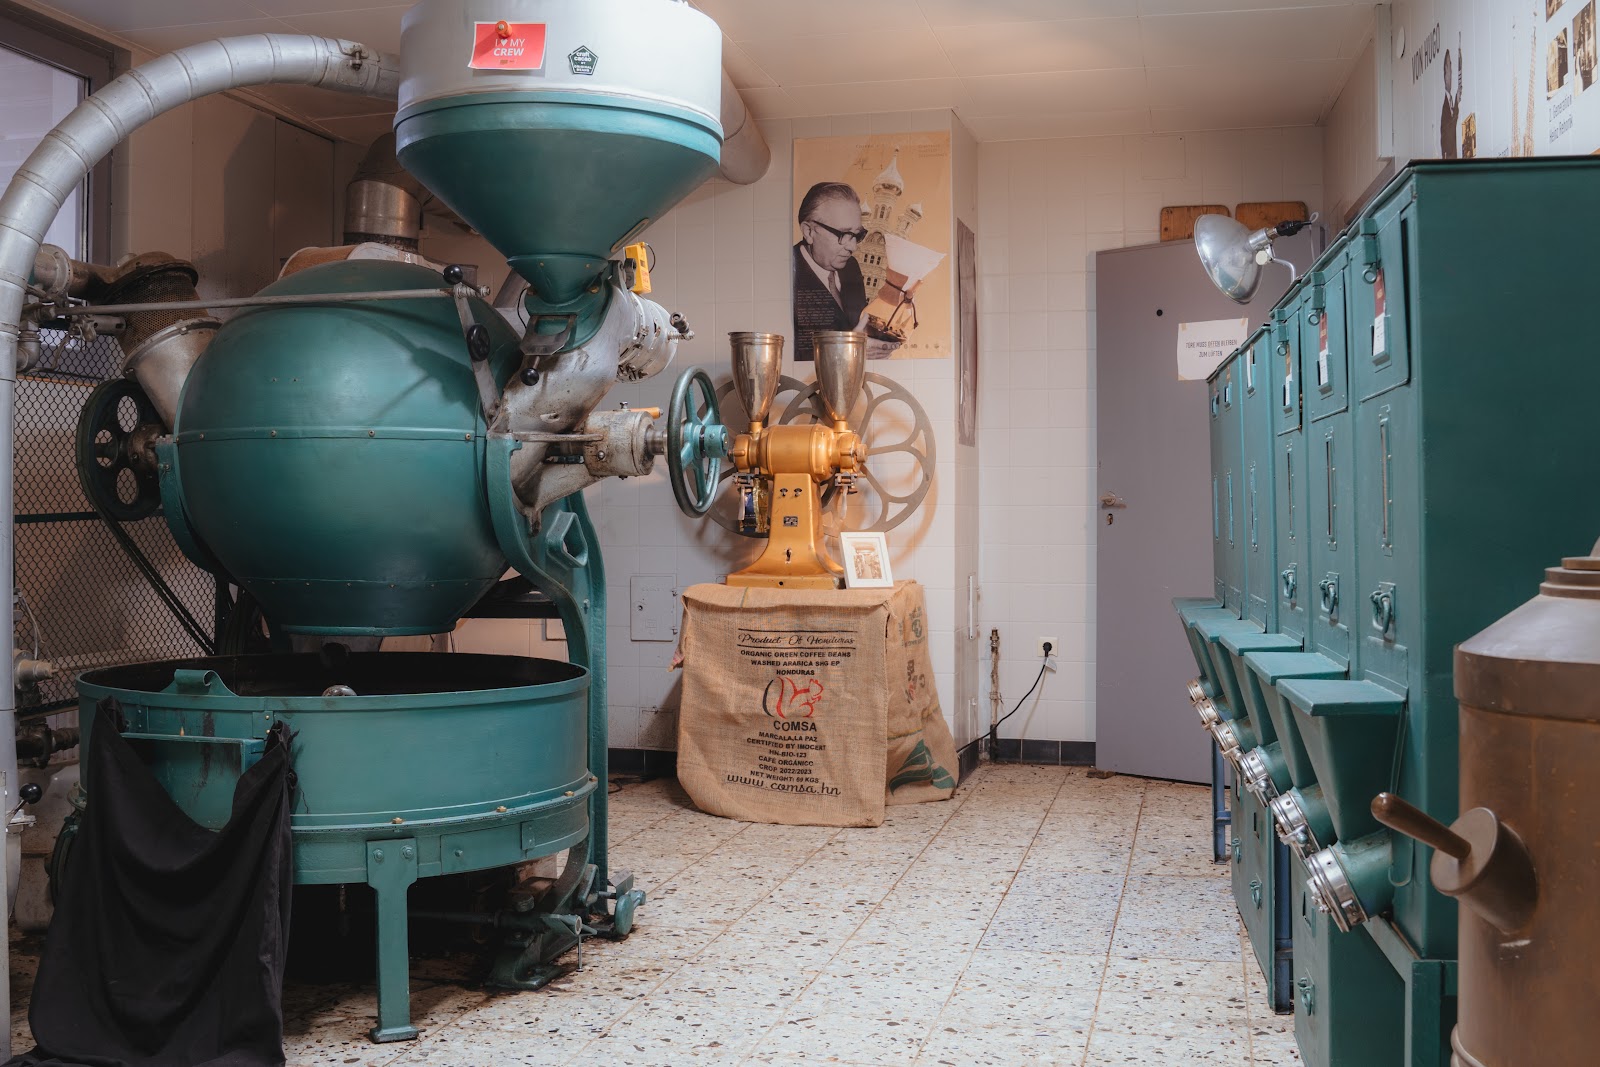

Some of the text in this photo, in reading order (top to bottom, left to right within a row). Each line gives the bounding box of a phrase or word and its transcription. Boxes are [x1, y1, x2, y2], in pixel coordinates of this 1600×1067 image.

[509, 38, 526, 47] MY
[493, 47, 525, 57] CREW
[737, 633, 855, 646] Product Of Honduras
[740, 649, 772, 658] ORGANIC
[751, 659, 781, 667] WASHED
[773, 720, 817, 732] COMSA
[746, 737, 784, 749] CERTIFIED
[797, 743, 826, 751] IMOCERT
[768, 749, 807, 758] HN-BIO-123
[758, 763, 812, 775] CROP 2022/2023
[750, 770, 764, 778] NET
